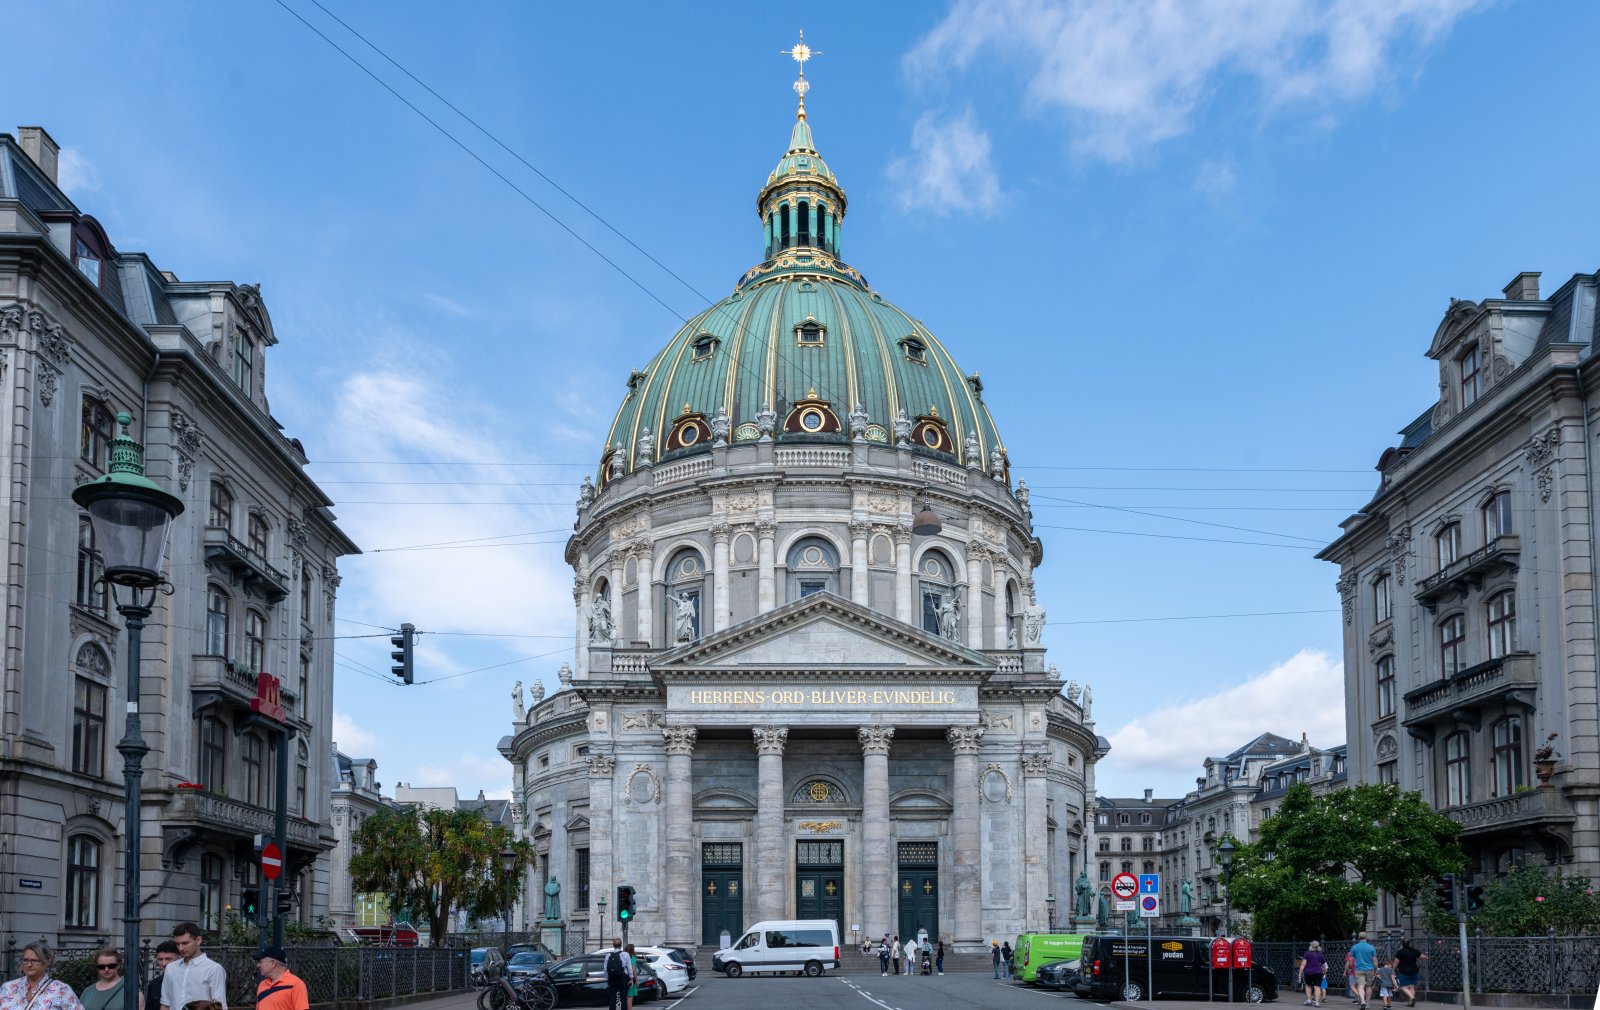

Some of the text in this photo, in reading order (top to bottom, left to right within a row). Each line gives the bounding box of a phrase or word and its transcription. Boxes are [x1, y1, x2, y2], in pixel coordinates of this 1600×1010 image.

[691, 691, 955, 704] HERRENS ORD BLIVER EVINDELIG
[1162, 951, 1184, 960] jeudan
